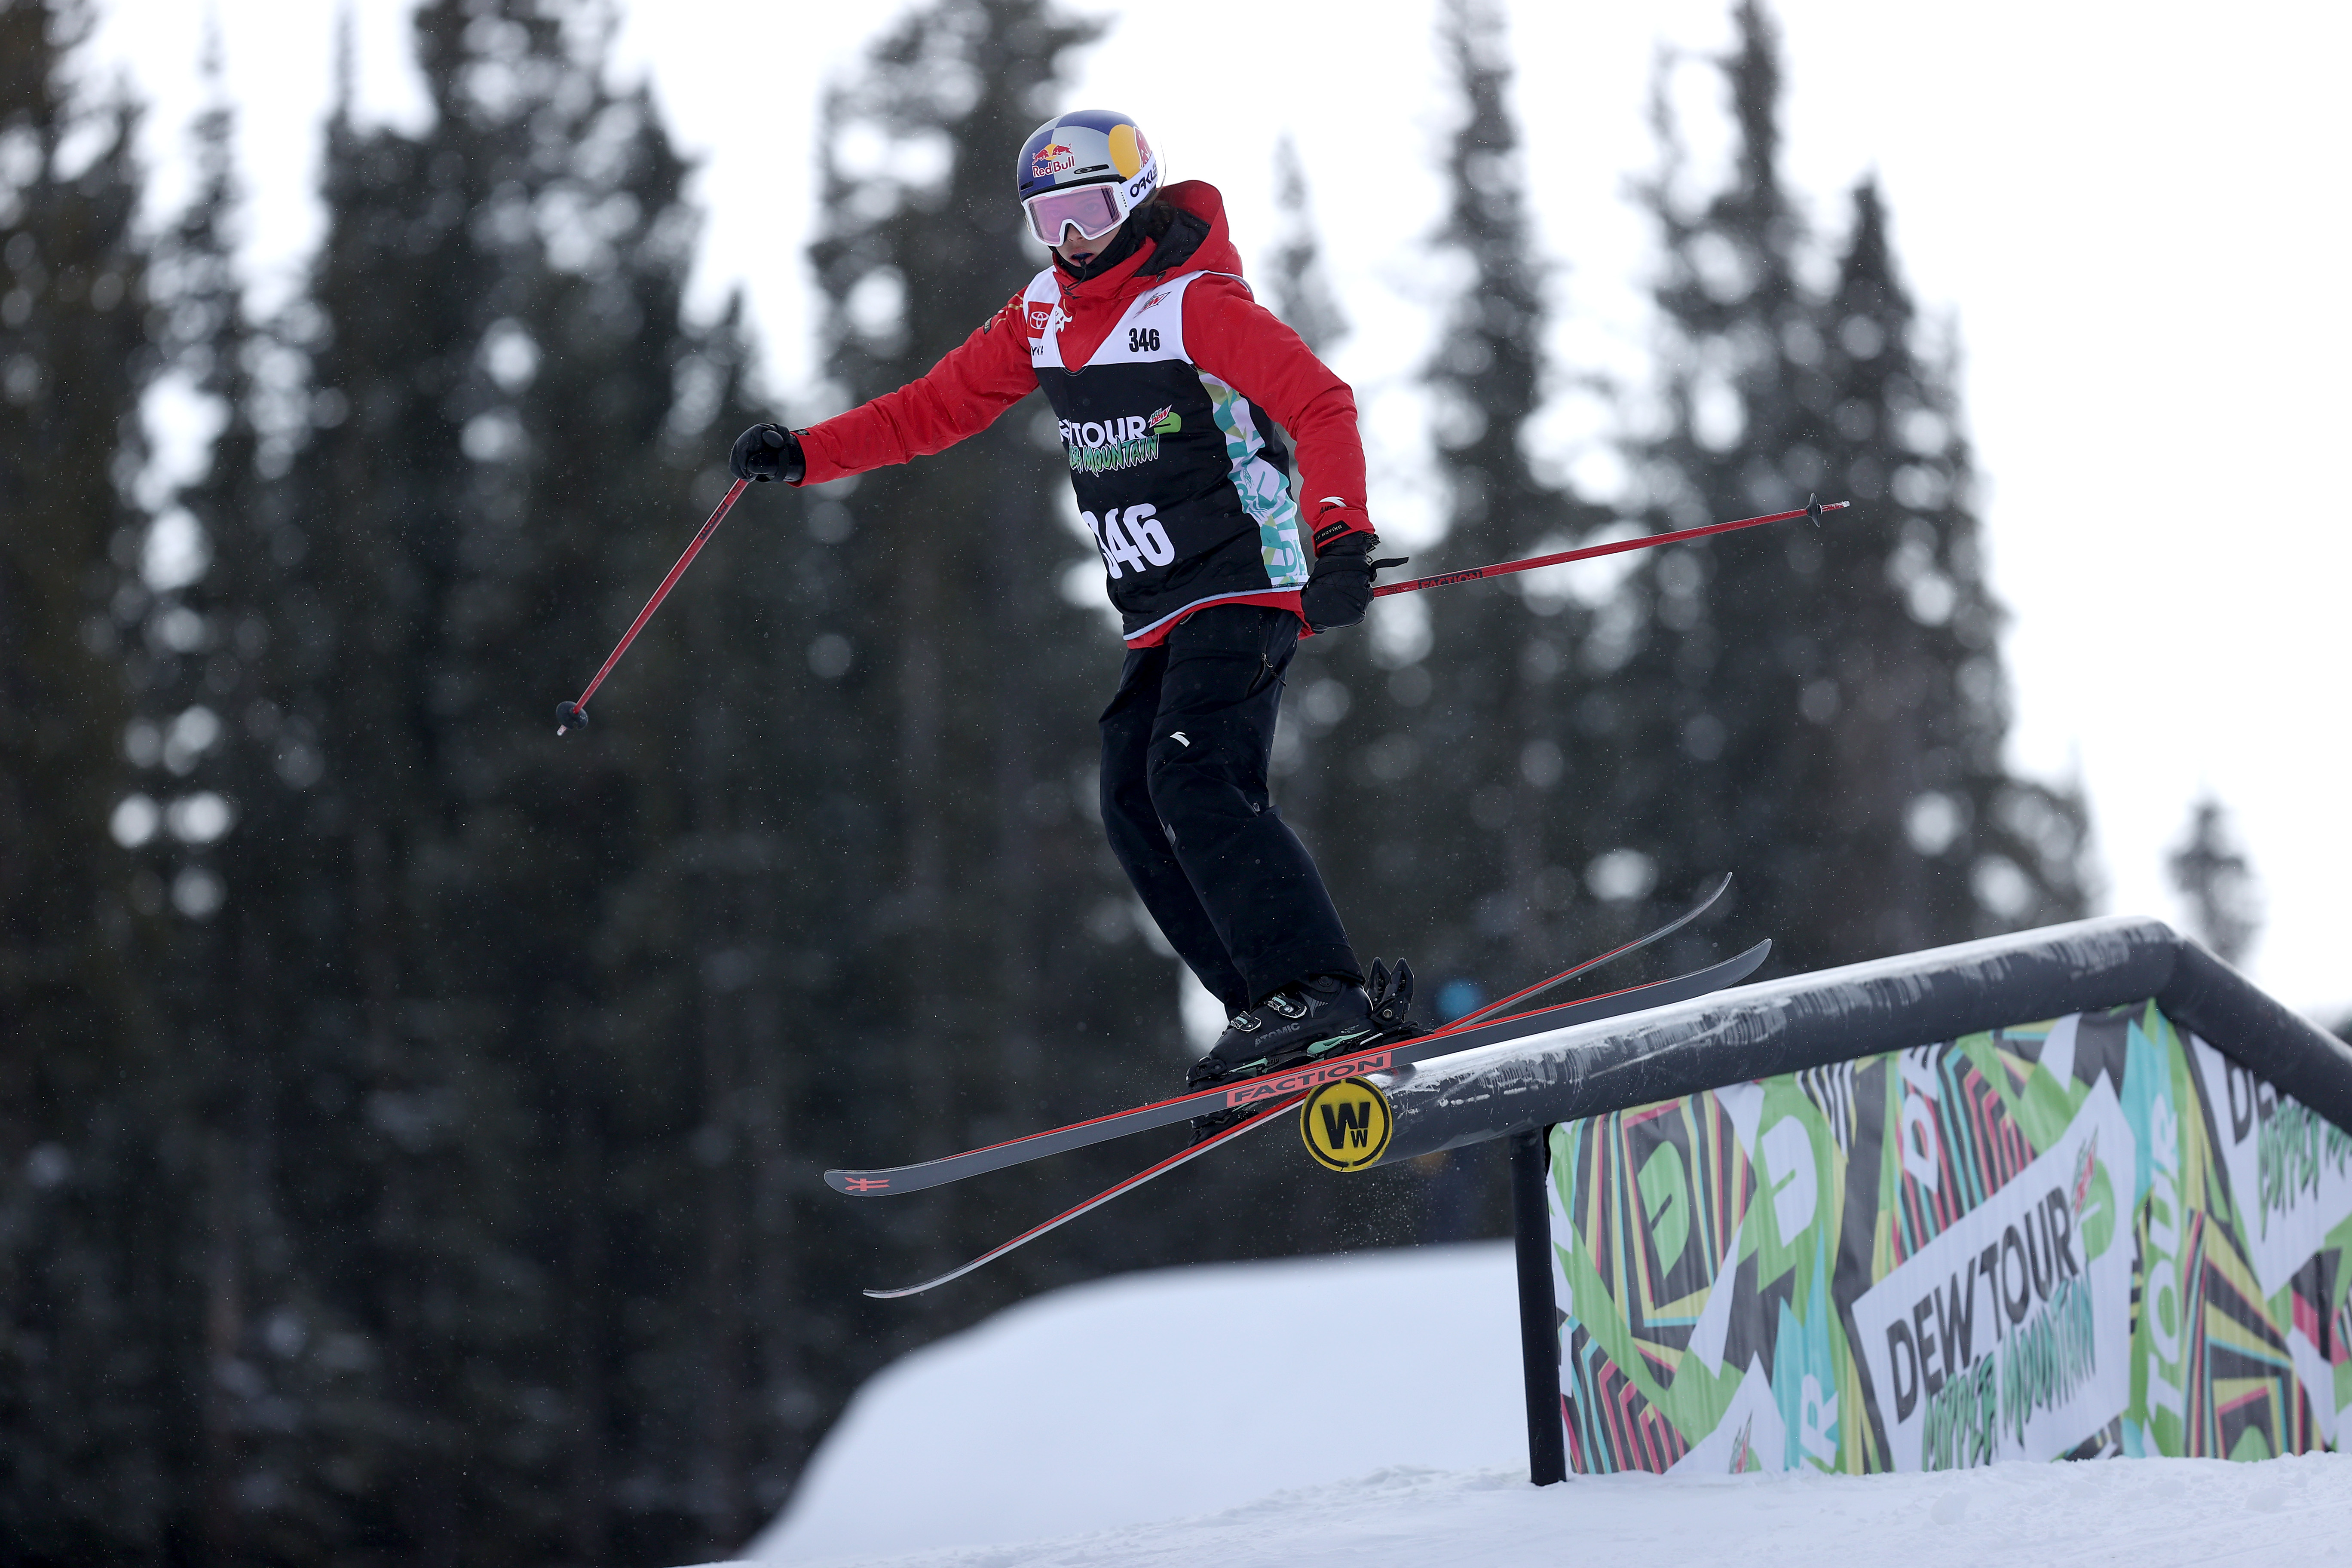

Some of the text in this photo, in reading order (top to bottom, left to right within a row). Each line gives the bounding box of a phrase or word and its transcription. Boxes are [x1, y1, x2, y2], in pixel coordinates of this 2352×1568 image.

[1032, 155, 1075, 177] Red Bull
[1128, 328, 1160, 352] 346
[1083, 433, 1160, 477] MOUNTAIN
[1321, 525, 1342, 537] MOVING
[1421, 571, 1480, 589] FACTION
[1255, 1022, 1301, 1048] ATOMIC
[1234, 1056, 1384, 1103] FACTION
[2146, 1092, 2183, 1422] TOUR
[1886, 1185, 2079, 1425] DEW TOUR
